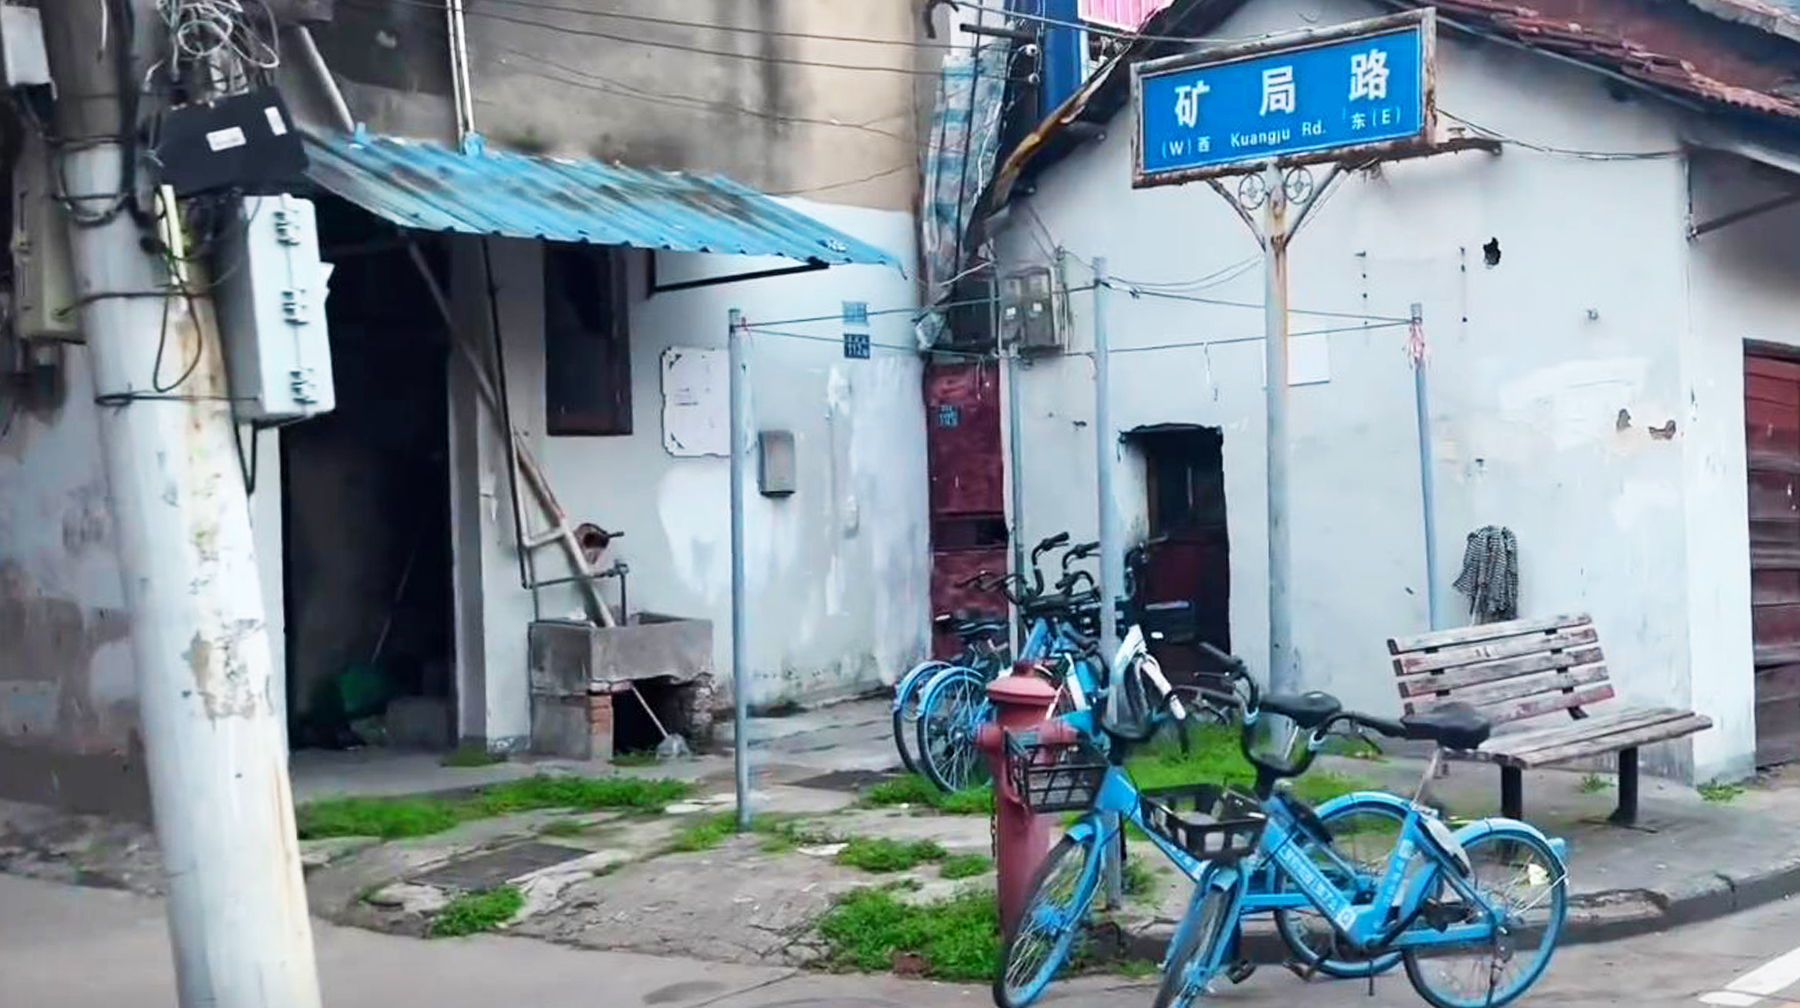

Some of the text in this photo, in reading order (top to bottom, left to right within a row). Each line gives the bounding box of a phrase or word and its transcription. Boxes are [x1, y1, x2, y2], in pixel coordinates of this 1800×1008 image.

[1174, 49, 1391, 128] 矿局路
[1230, 128, 1291, 149] Kuangju
[1302, 120, 1327, 137] Rd.
